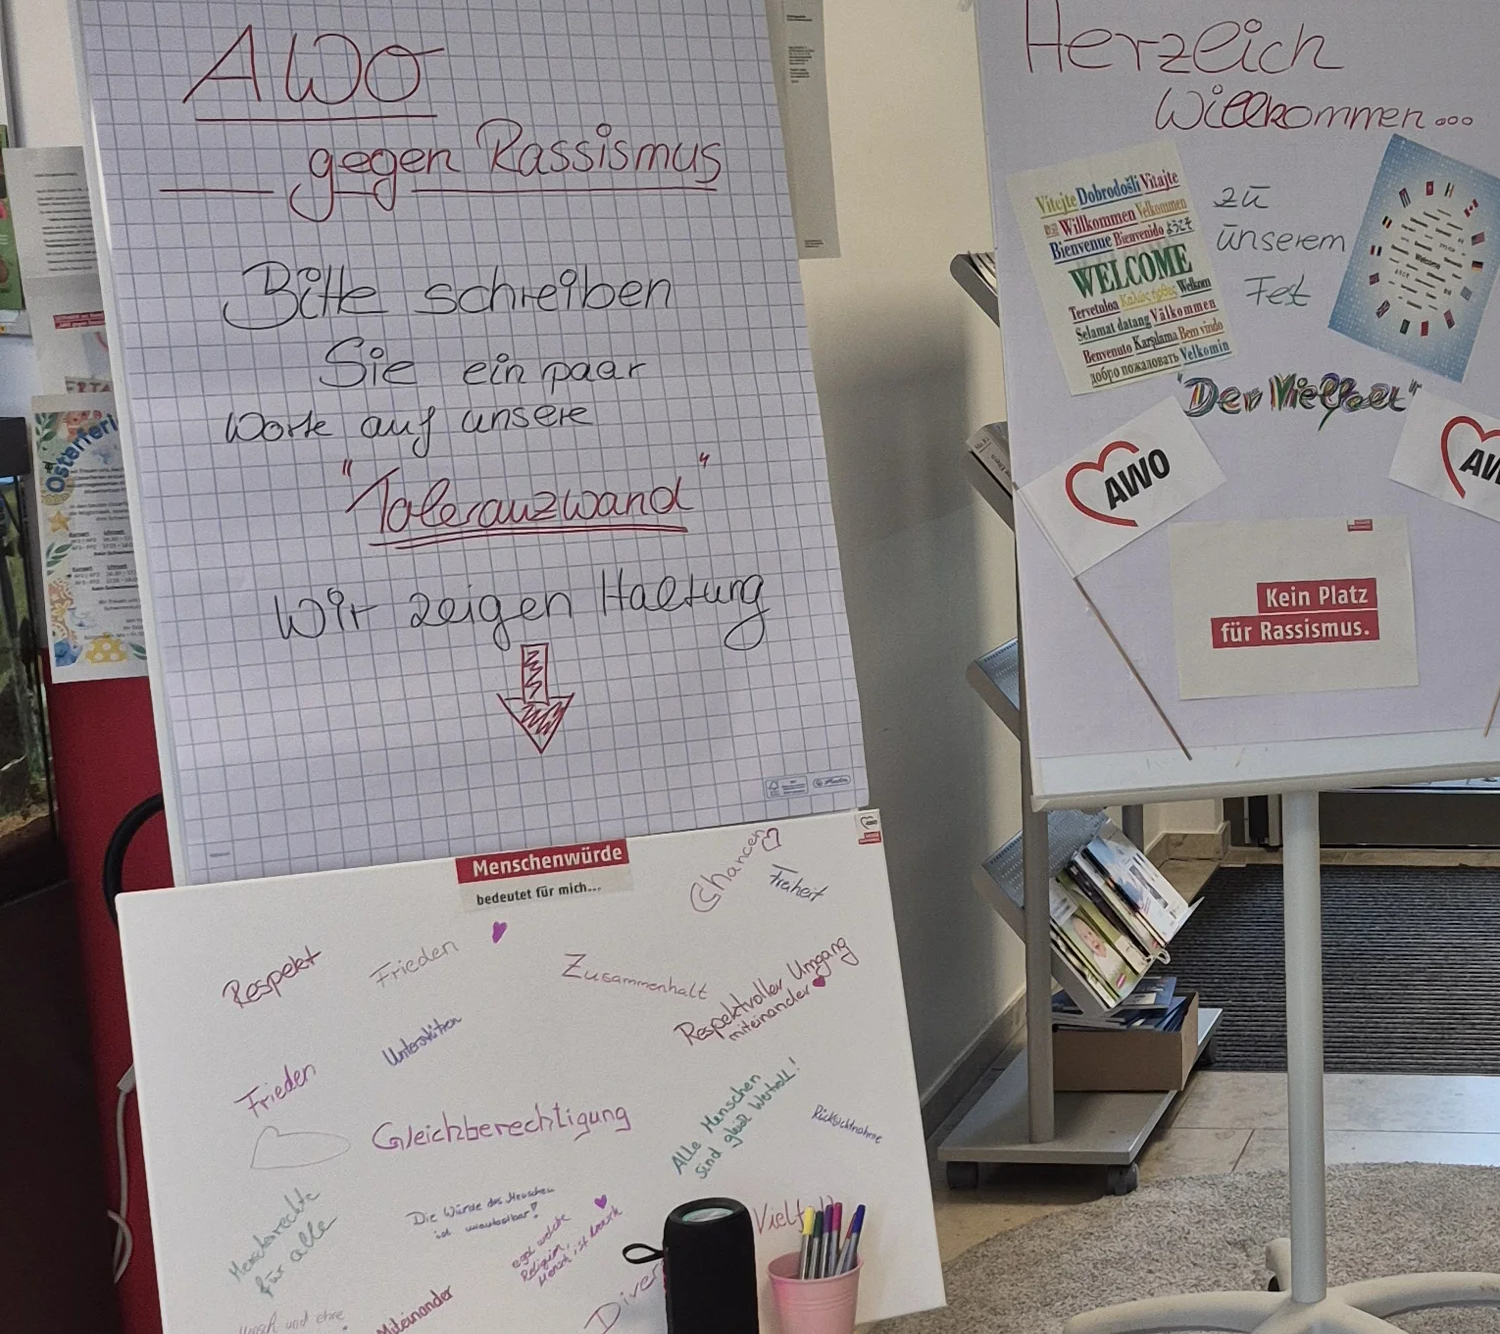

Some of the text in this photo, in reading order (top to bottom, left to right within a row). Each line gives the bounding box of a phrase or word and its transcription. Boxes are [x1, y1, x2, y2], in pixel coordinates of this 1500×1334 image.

[181, 23, 446, 105] AWO
[289, 118, 722, 222] gegen Rassismus
[1076, 176, 1141, 206] Dobrodošli
[1058, 208, 1137, 237] Willkommen
[1135, 197, 1187, 219] Velkommen
[1050, 222, 1164, 261] Bienvenue Bienvenido
[1068, 243, 1193, 299] WELCOME
[1177, 277, 1211, 295] Welkom
[1244, 275, 1312, 307] Fest
[223, 260, 673, 330] Bitte schreiben
[1068, 299, 1119, 322] Tervetuloa
[1075, 298, 1217, 343] Selamat datang Välkommen
[1083, 342, 1133, 365] Benvenuto
[1178, 325, 1199, 341] Bem
[1200, 318, 1224, 336] vindo
[319, 336, 646, 395] Sie ein paar
[1090, 352, 1179, 386] добро пожаловать
[1180, 339, 1230, 361] Velkomin
[225, 405, 594, 458] Worte auf unsere
[1104, 448, 1172, 512] AWO
[276, 568, 772, 651] Wir zeigen Haltung
[1265, 582, 1369, 609] Kein Platz
[1220, 614, 1371, 645] für Rassismus.
[473, 844, 622, 878] Menschenwürde
[476, 882, 602, 906] bedeutet für mich...
[222, 945, 322, 1009] Respekt
[369, 940, 460, 988] Frieden
[561, 953, 708, 1001] Zusammenhalt
[673, 936, 860, 1046] Respektvoller Umgang
[729, 984, 811, 1042] miteinander
[234, 1062, 317, 1119] Frieden
[700, 1073, 762, 1134] Menschen
[371, 1102, 632, 1152] Gleichberechtigung
[405, 1210, 438, 1225] Die
[443, 1202, 482, 1218] Würde
[753, 1195, 834, 1235] Vielf
[290, 1216, 339, 1263] alle
[286, 1310, 309, 1330] und
